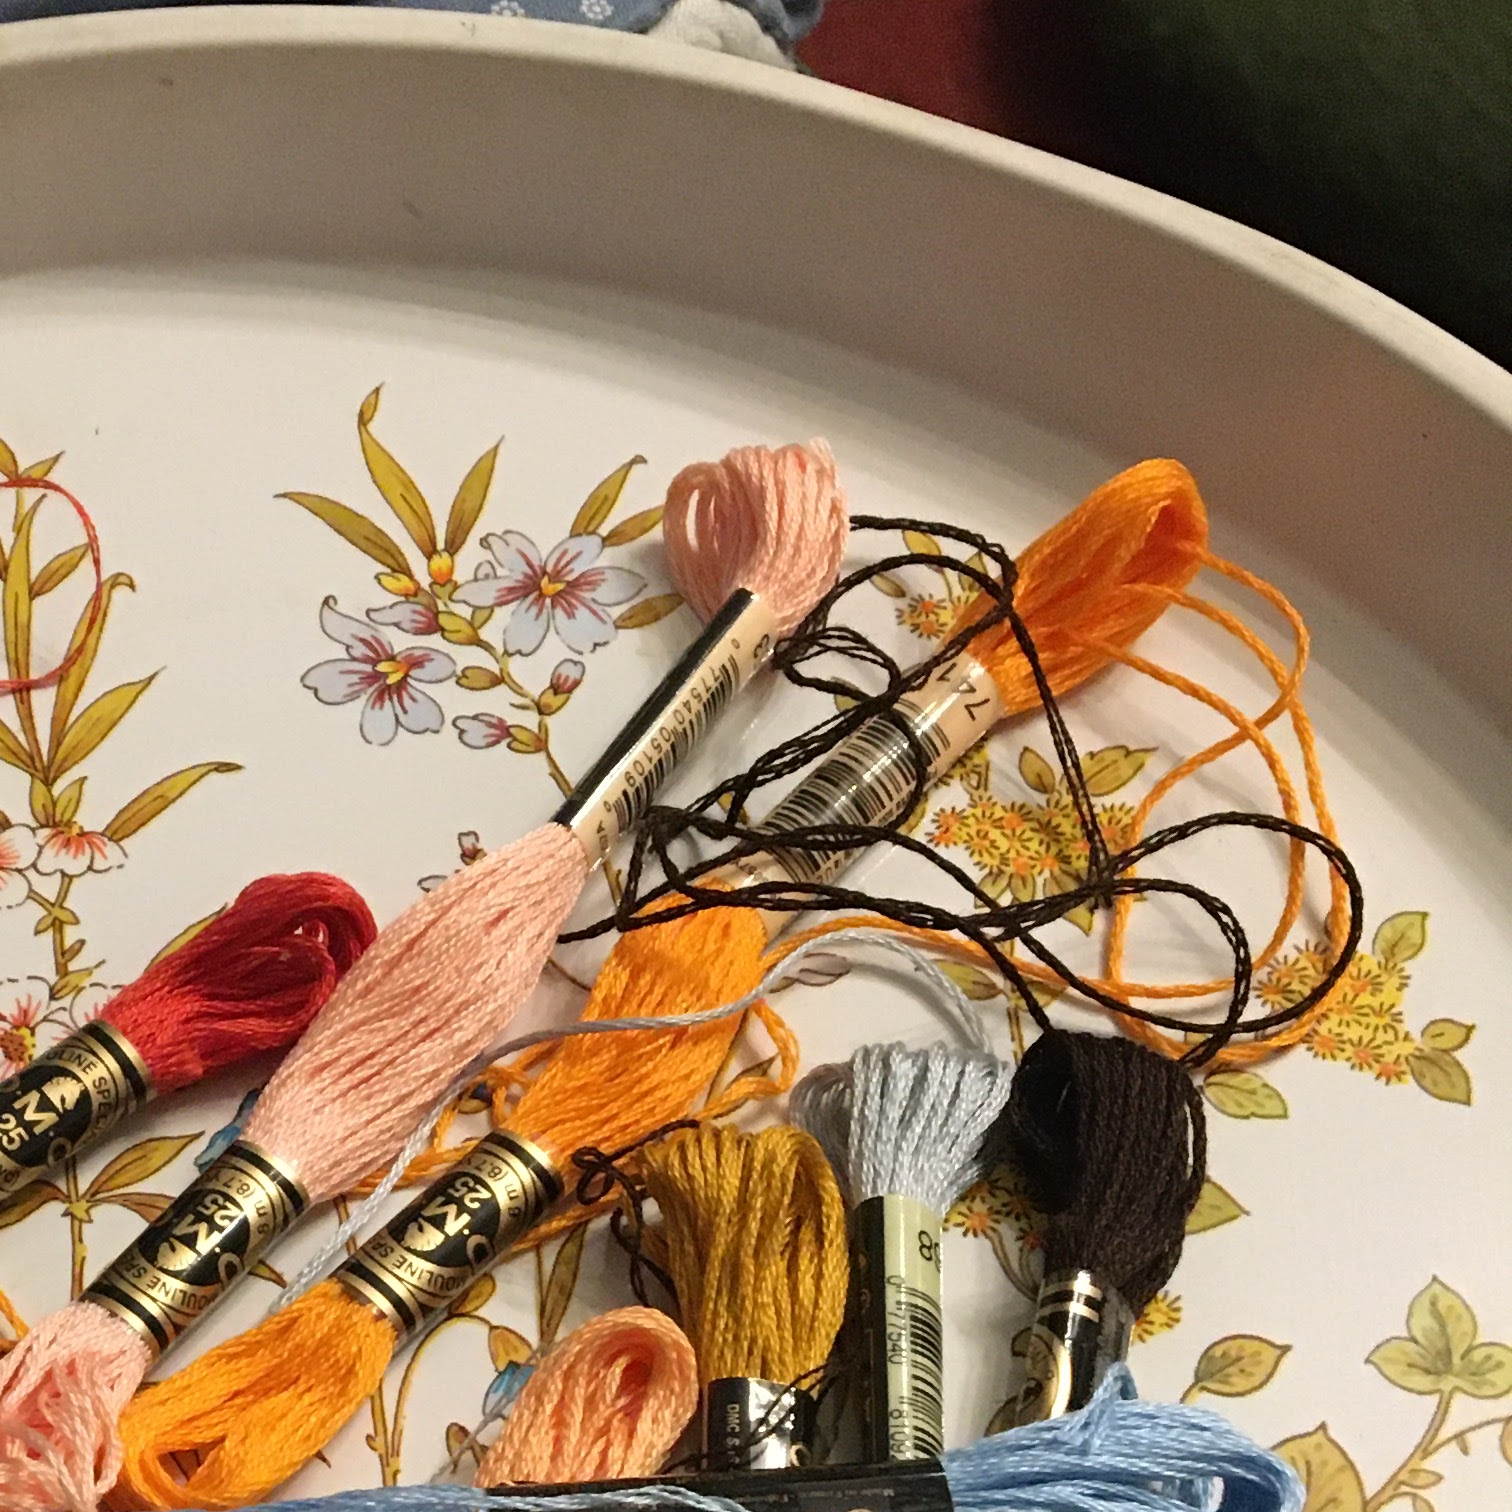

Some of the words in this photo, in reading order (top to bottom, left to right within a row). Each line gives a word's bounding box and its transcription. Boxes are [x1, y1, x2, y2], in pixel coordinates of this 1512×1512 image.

[667, 661, 726, 730] 77540
[930, 659, 996, 722] 741
[620, 722, 675, 788] 05109
[195, 1187, 242, 1233] 25
[446, 1168, 493, 1215] 25
[726, 1403, 740, 1433] DMC
